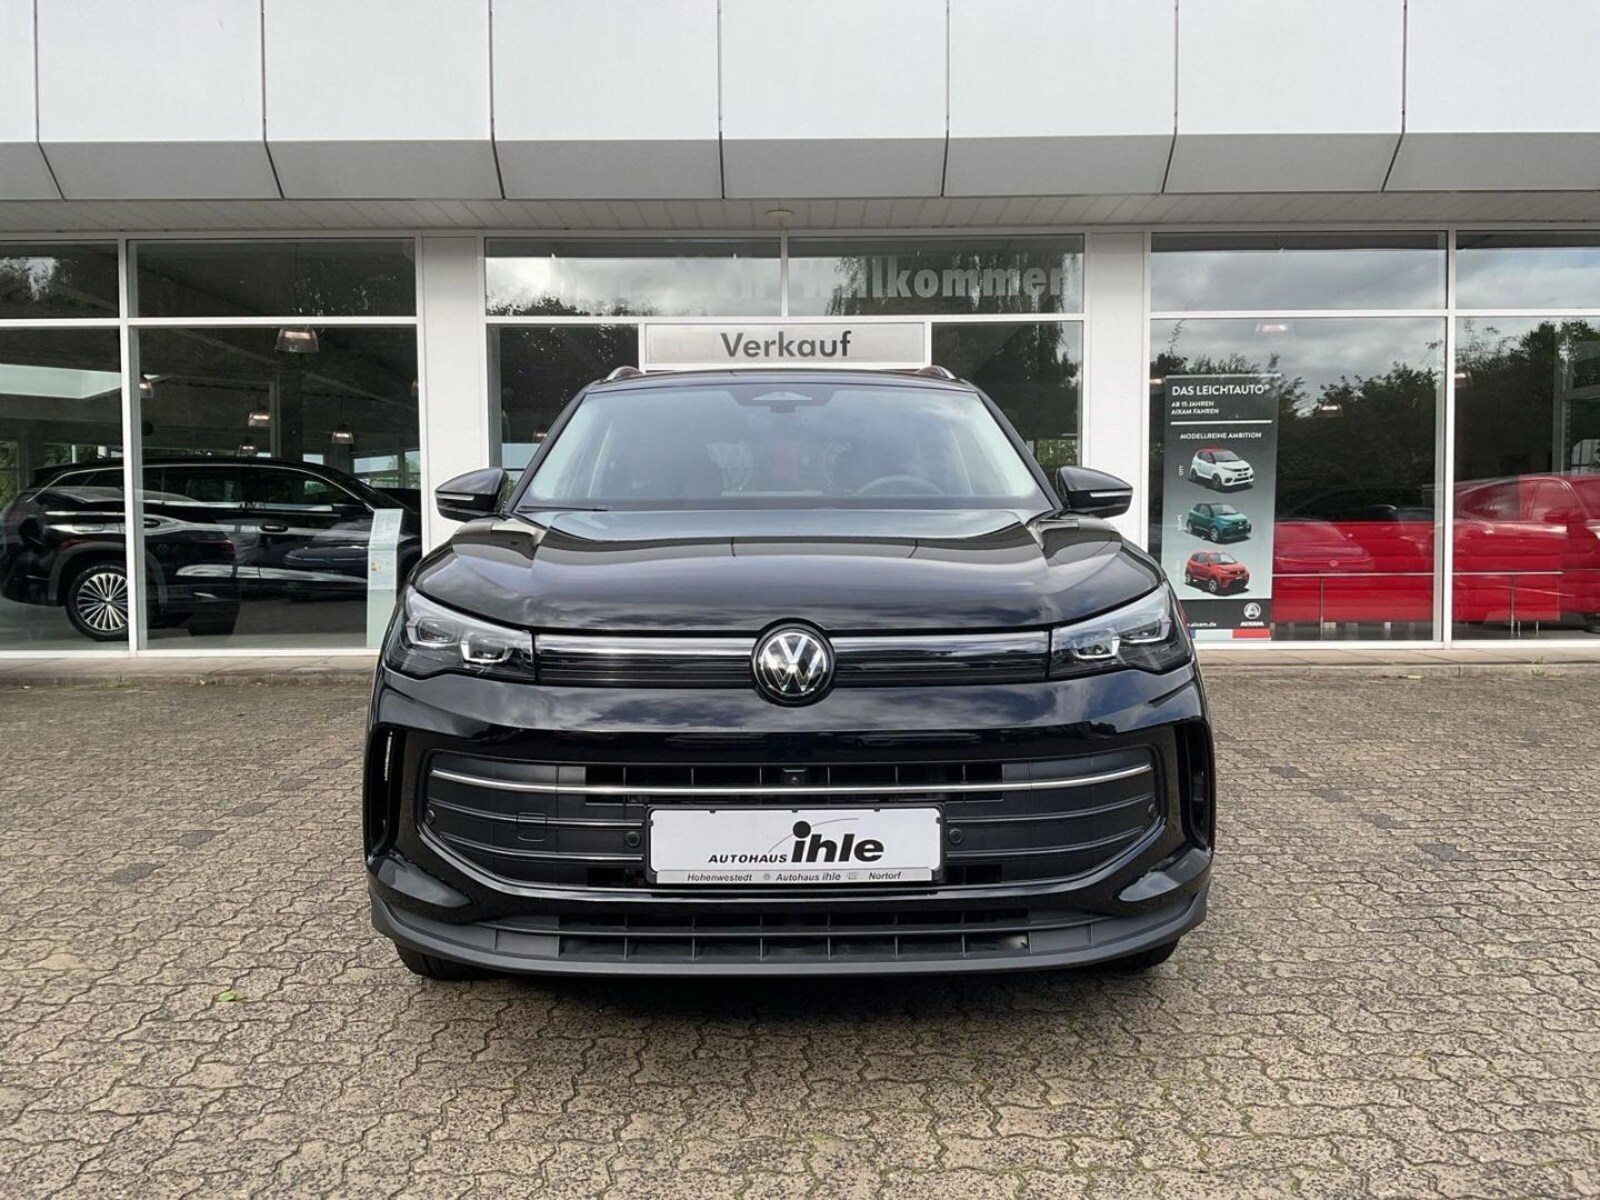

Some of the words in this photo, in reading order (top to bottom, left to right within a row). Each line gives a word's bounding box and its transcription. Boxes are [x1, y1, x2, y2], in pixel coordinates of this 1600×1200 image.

[720, 330, 852, 358] Verkauf
[1172, 385, 1194, 396] DAS
[708, 854, 788, 864] AUTOHAUS
[791, 820, 885, 863] ihle
[687, 873, 753, 882] Hohenwestedt
[776, 873, 819, 882] Autohaus
[822, 872, 841, 881] ihle
[868, 872, 902, 880] Nortorf
